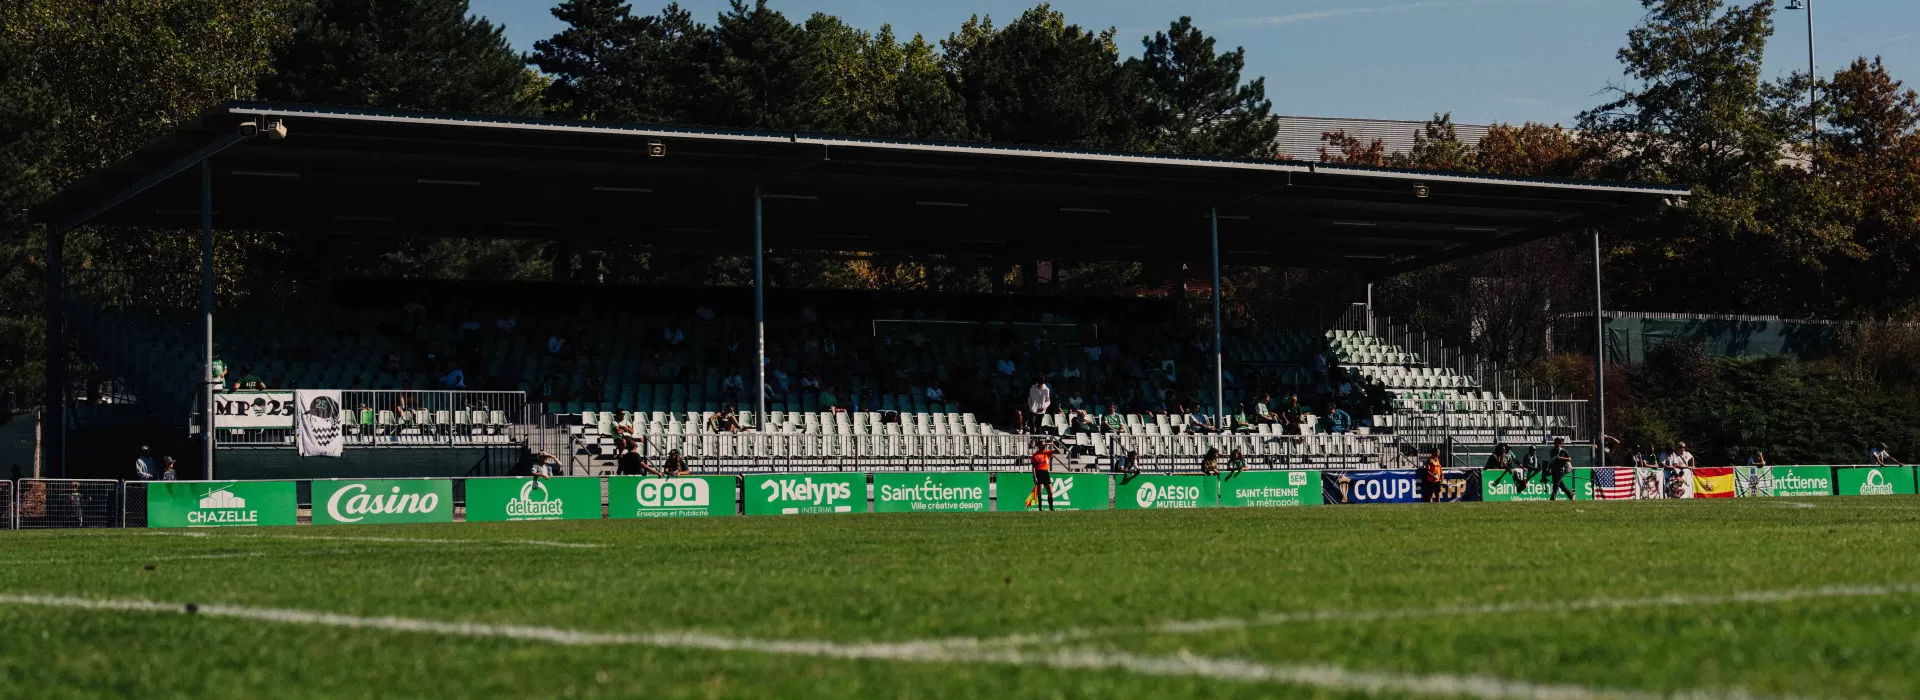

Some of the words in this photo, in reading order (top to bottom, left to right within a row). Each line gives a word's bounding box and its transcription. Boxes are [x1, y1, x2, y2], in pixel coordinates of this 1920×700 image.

[215, 400, 250, 416] MP
[267, 400, 294, 416] 25
[780, 477, 851, 505] Kelyps
[1354, 478, 1422, 500] COUPE
[327, 484, 438, 522] Casino
[507, 498, 562, 515] deltanet
[911, 502, 926, 510] Ville
[927, 501, 958, 510] créative
[959, 501, 983, 511] design
[187, 510, 258, 523] CHAZELLE
